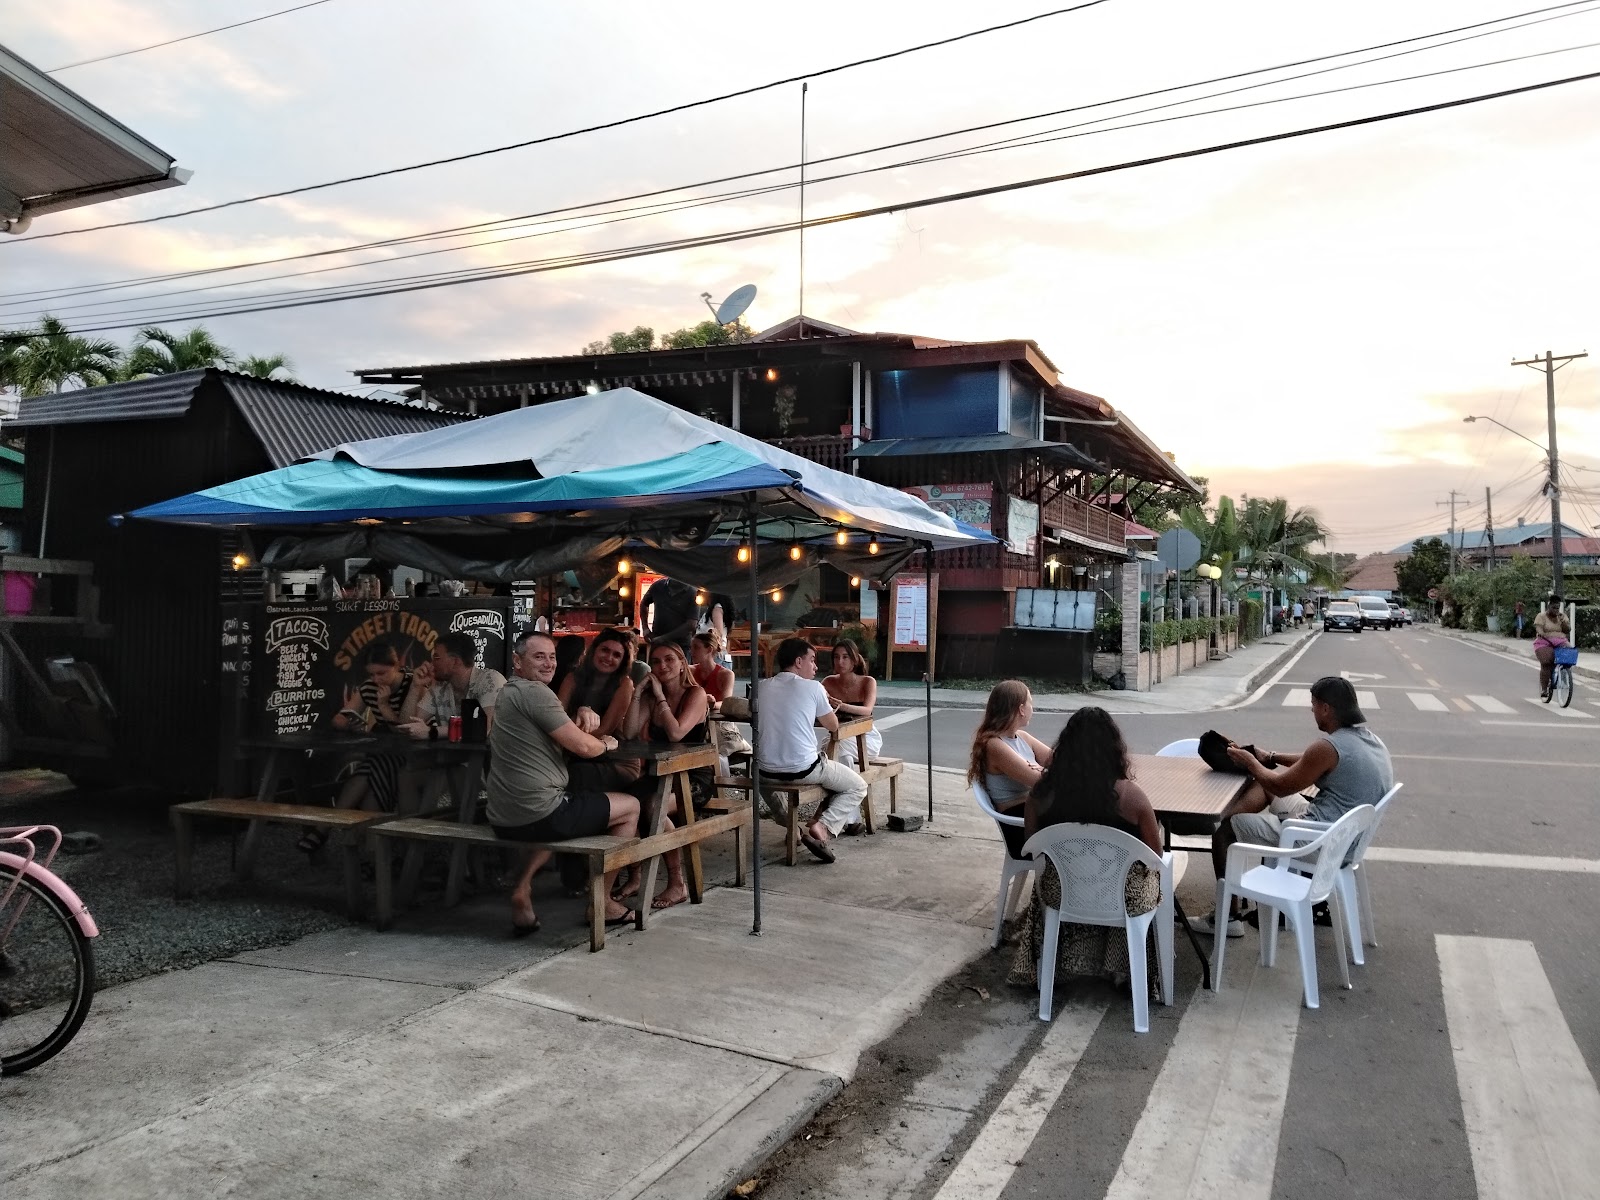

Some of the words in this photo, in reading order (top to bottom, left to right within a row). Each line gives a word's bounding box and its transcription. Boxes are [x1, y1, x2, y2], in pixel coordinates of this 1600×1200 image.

[222, 618, 250, 632] CHIS
[276, 620, 320, 637] TACOS
[335, 611, 393, 671] STREET
[400, 610, 439, 660] TACO
[280, 644, 298, 654] BEEF
[280, 653, 307, 663] CHICKEN
[222, 660, 252, 672] NACOS
[280, 662, 299, 672] PORK
[279, 679, 302, 688] VEGGIE
[278, 705, 298, 716] BEEF
[277, 714, 308, 726] CHICKEN
